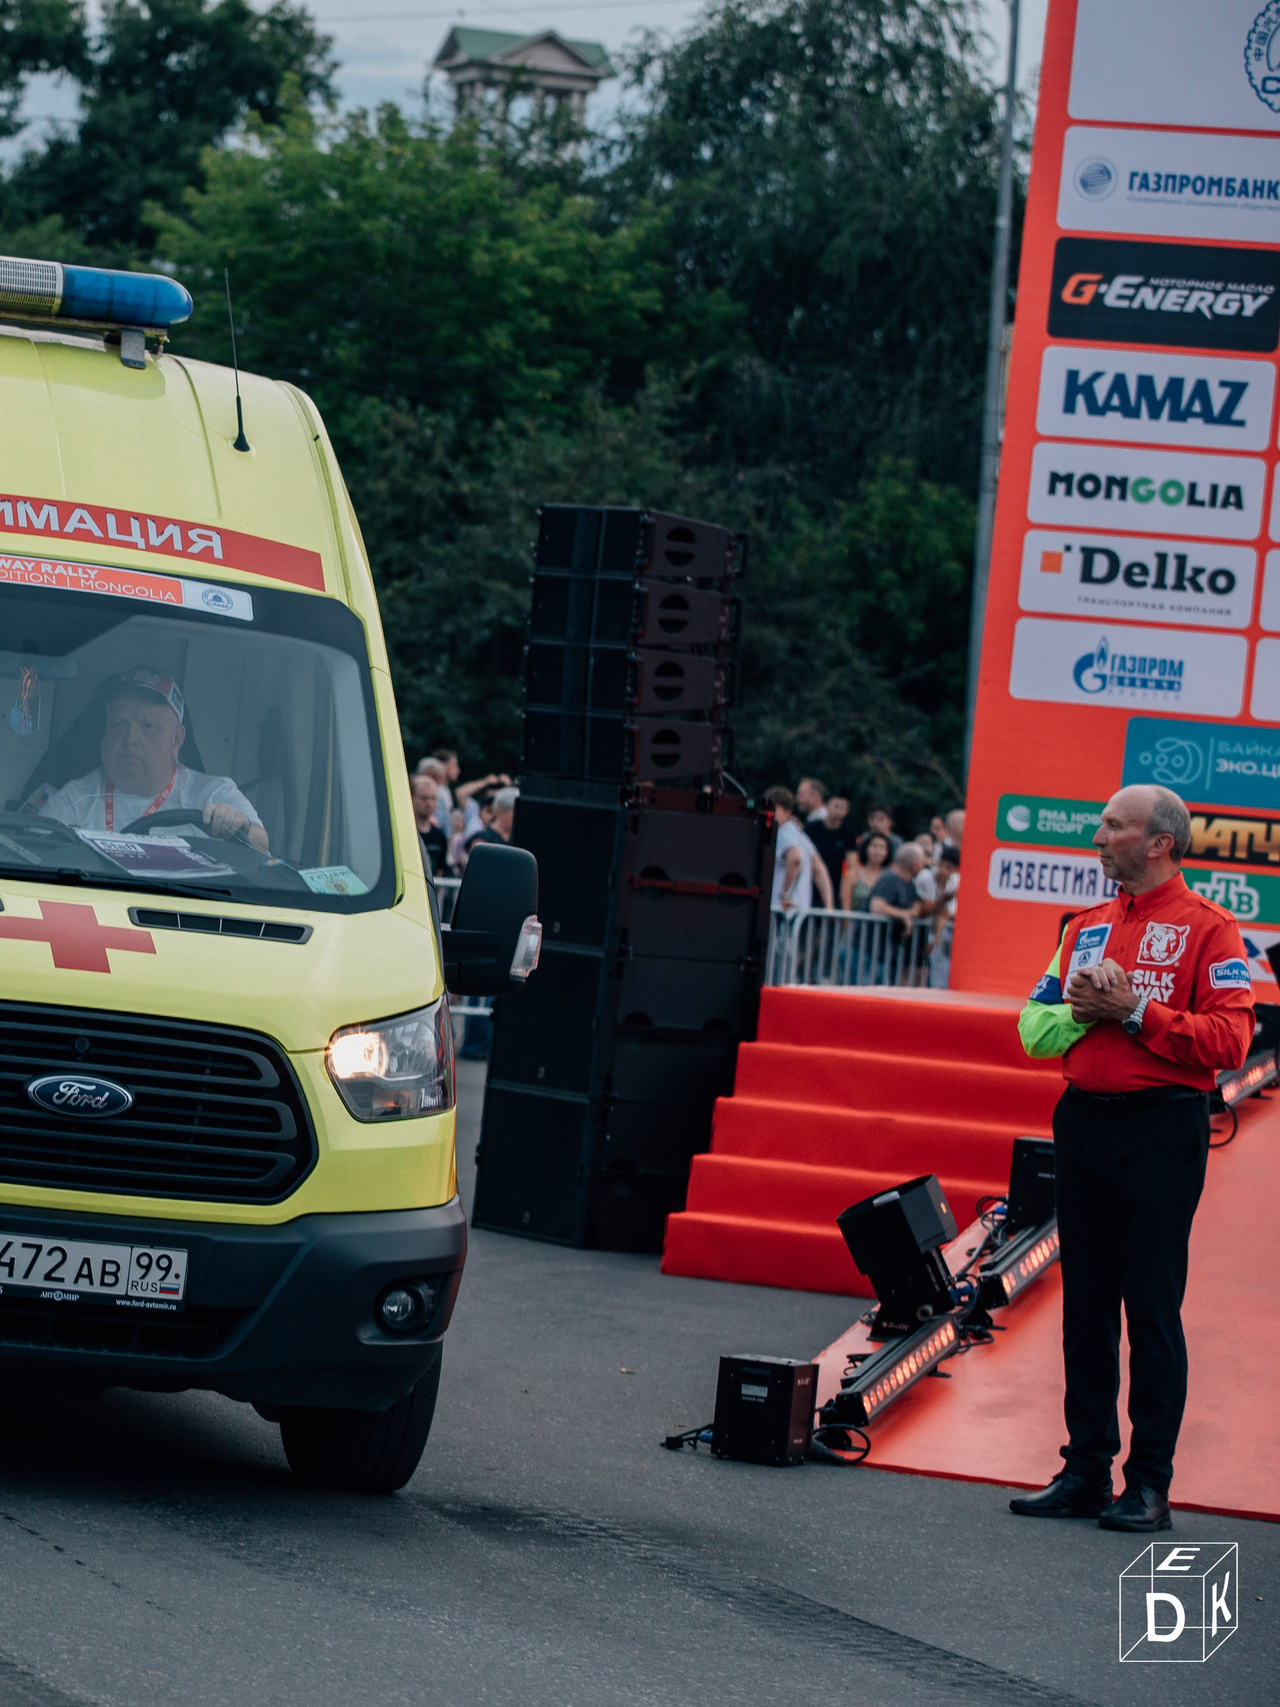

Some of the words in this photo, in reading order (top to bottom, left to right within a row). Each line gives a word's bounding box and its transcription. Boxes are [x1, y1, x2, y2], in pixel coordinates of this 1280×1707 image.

[1128, 171, 1280, 200] ГАЗПРОМБАНК
[1062, 368, 1250, 428] KAMAZ
[1047, 470, 1245, 511] MONGOLIA
[40, 563, 99, 579] RALLY
[1080, 546, 1237, 596] Delko
[80, 578, 177, 603] MONGOLIA
[1111, 653, 1185, 678] ГАЗПРОМ
[999, 859, 1098, 897] ИЗВЕСТИЯ
[1132, 969, 1176, 988] SILK
[1216, 968, 1240, 977] SILK
[1131, 984, 1174, 1003] WAY
[52, 1081, 110, 1109] Ford
[135, 1252, 173, 1281] 99
[130, 1280, 159, 1293] RUS
[116, 1299, 177, 1311] www.ford-avtomir.ru
